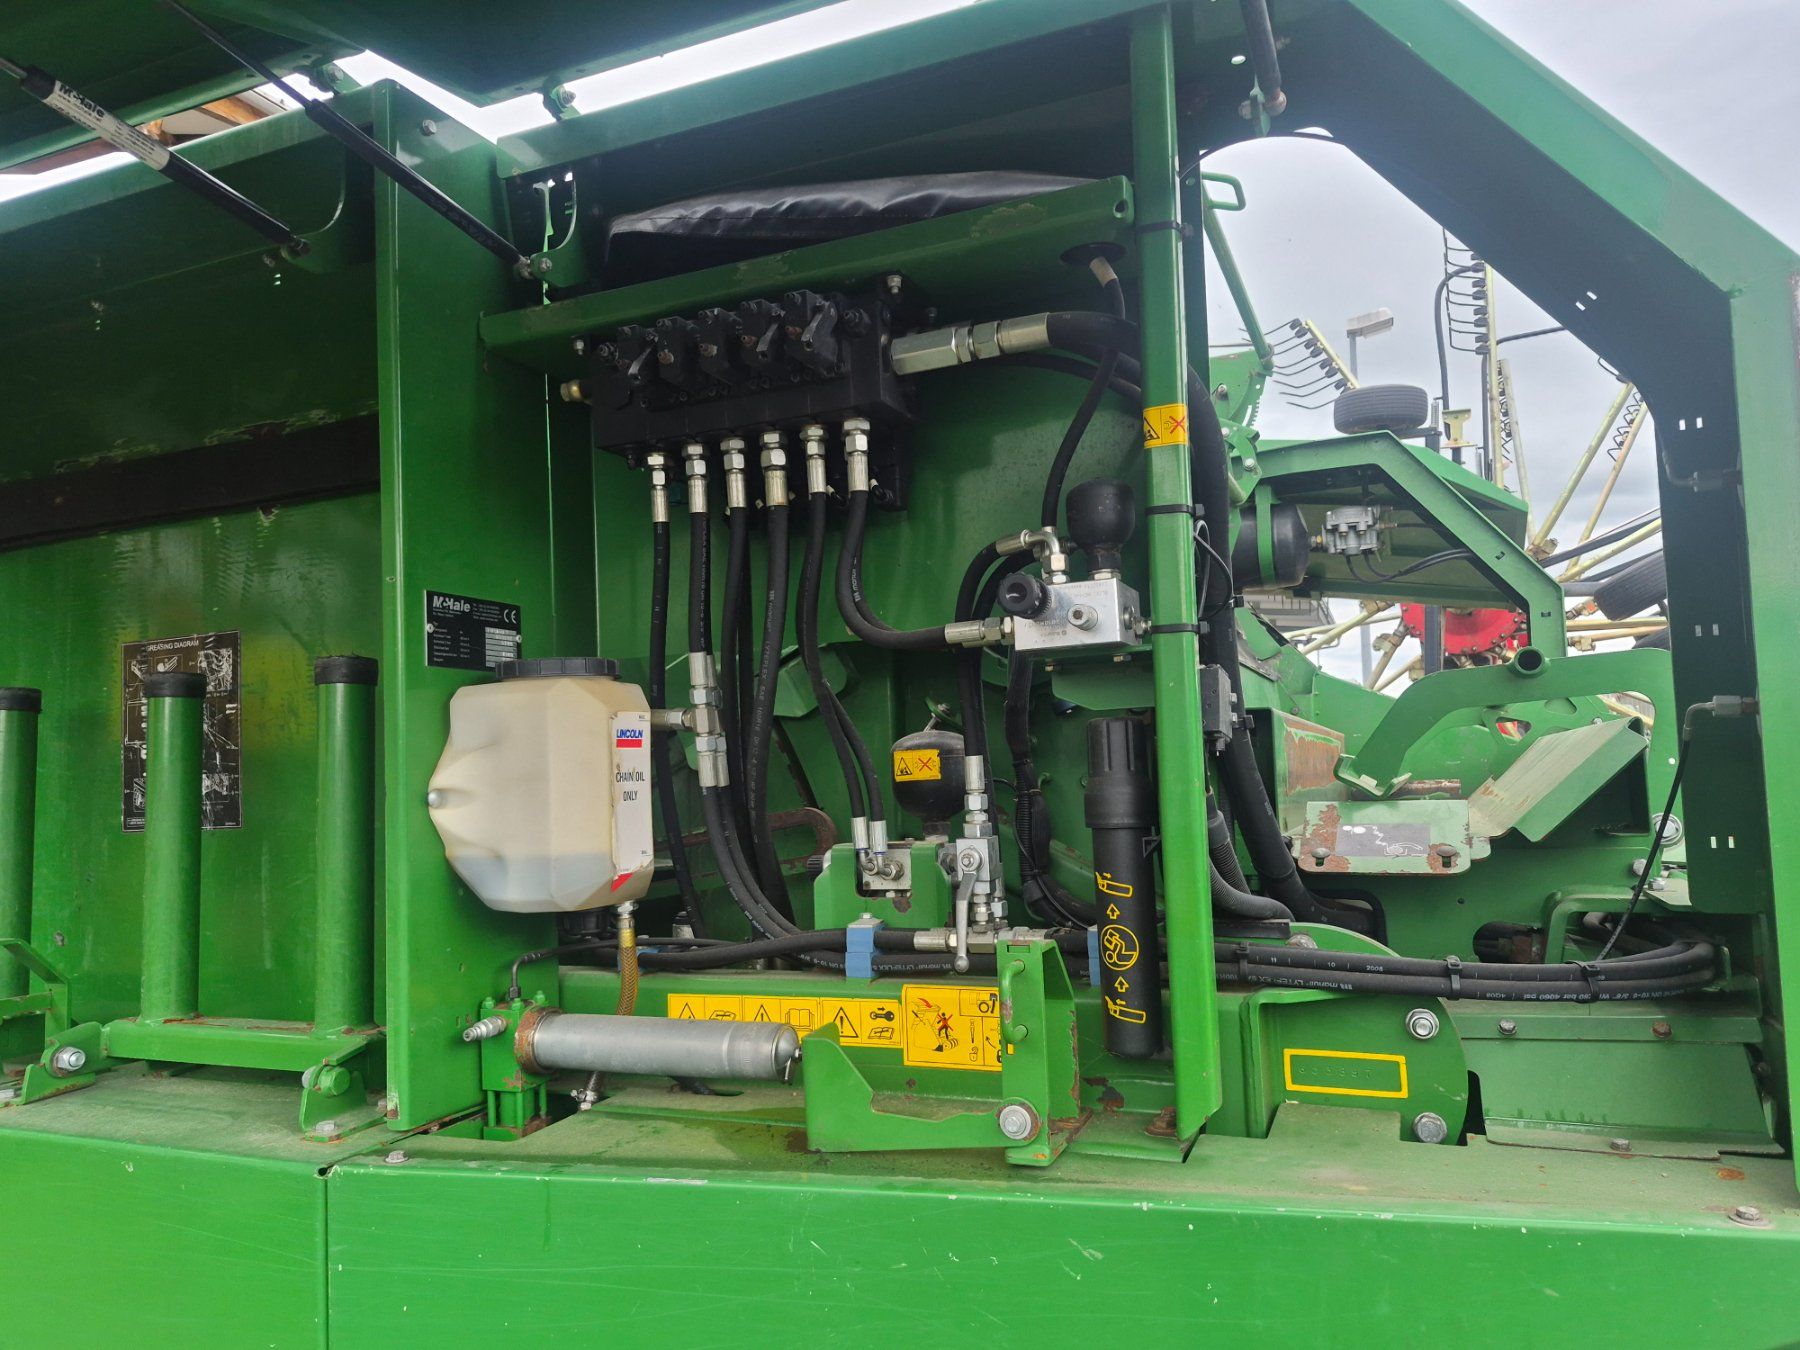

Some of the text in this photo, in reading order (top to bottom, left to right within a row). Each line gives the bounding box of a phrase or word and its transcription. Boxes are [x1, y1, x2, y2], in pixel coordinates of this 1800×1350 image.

[432, 595, 471, 613] McHale
[174, 639, 199, 649] DIAGRAM
[616, 729, 643, 739] LINCOLN
[616, 771, 645, 783] CHAIN OIL
[623, 790, 638, 802] ONLY
[1523, 993, 1537, 1001] psi
[1539, 993, 1560, 1001] 4060
[1563, 993, 1577, 1001] bar
